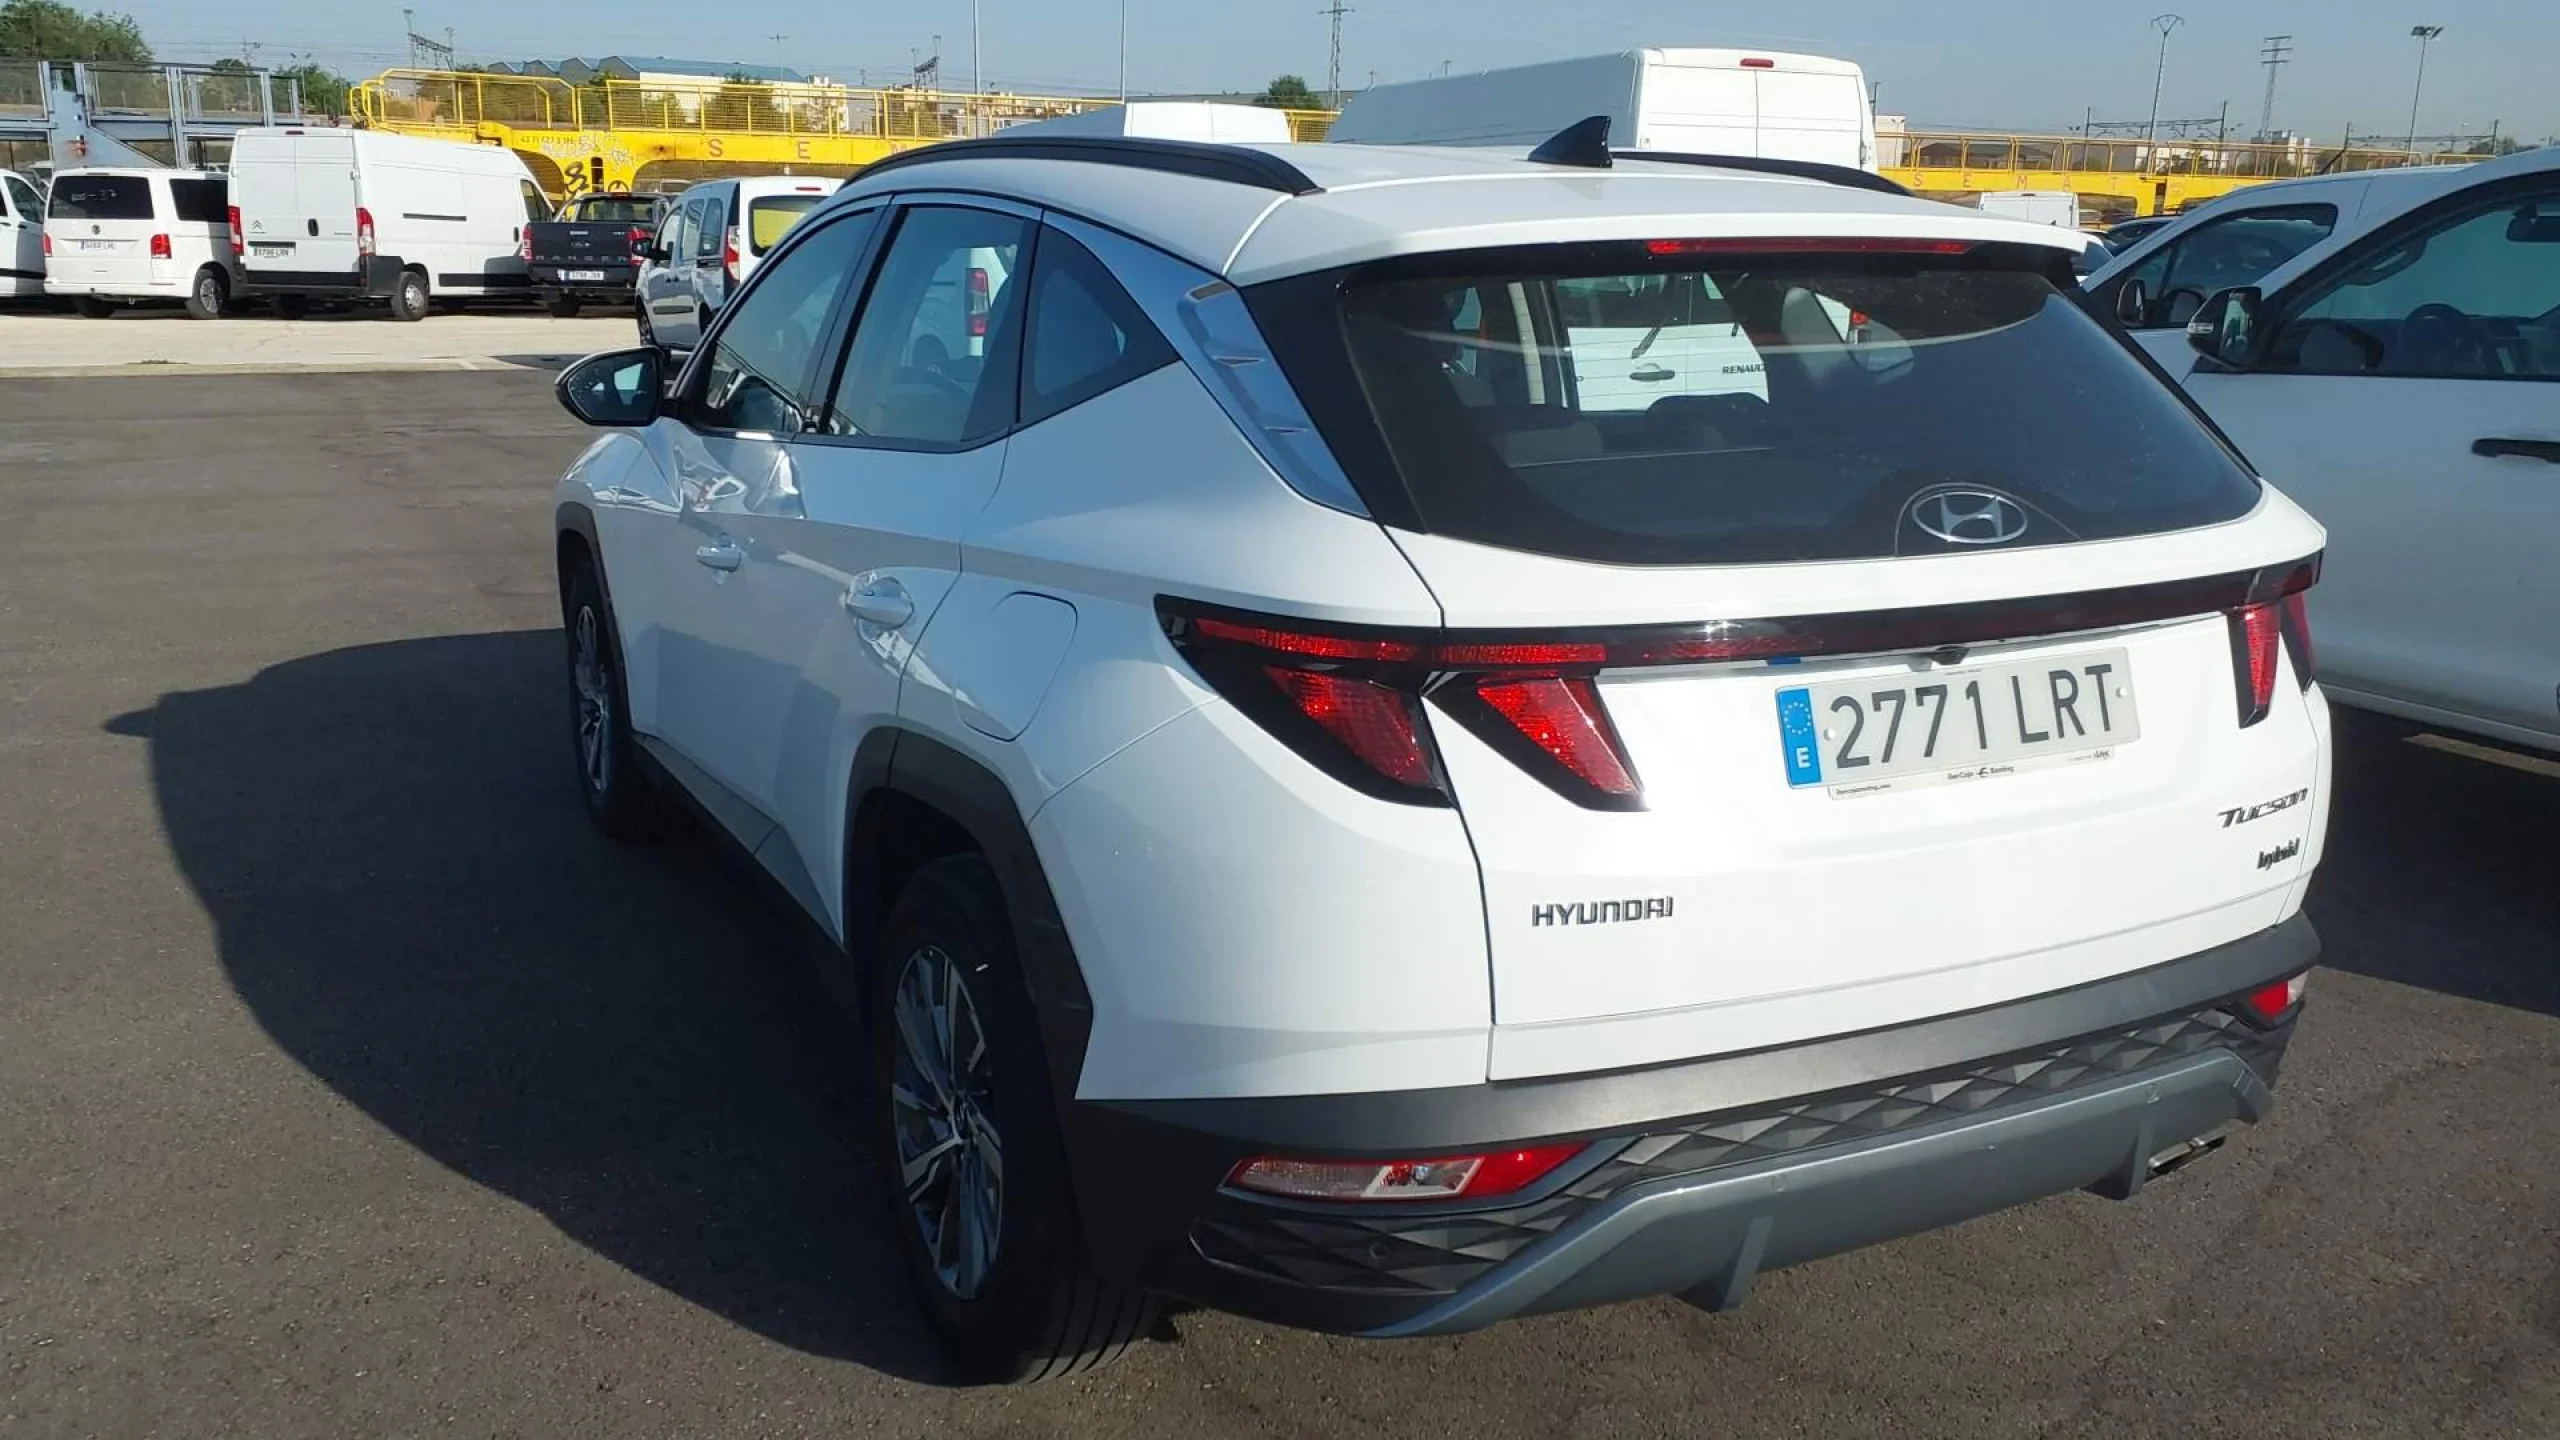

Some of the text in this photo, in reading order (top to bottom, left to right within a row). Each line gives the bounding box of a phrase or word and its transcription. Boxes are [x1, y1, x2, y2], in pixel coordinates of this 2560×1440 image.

[1831, 663, 2113, 769] 2771 LRT
[1796, 747, 1811, 769] E
[2256, 837, 2301, 871] hybrid
[1531, 896, 1674, 927] HYUNDAI
